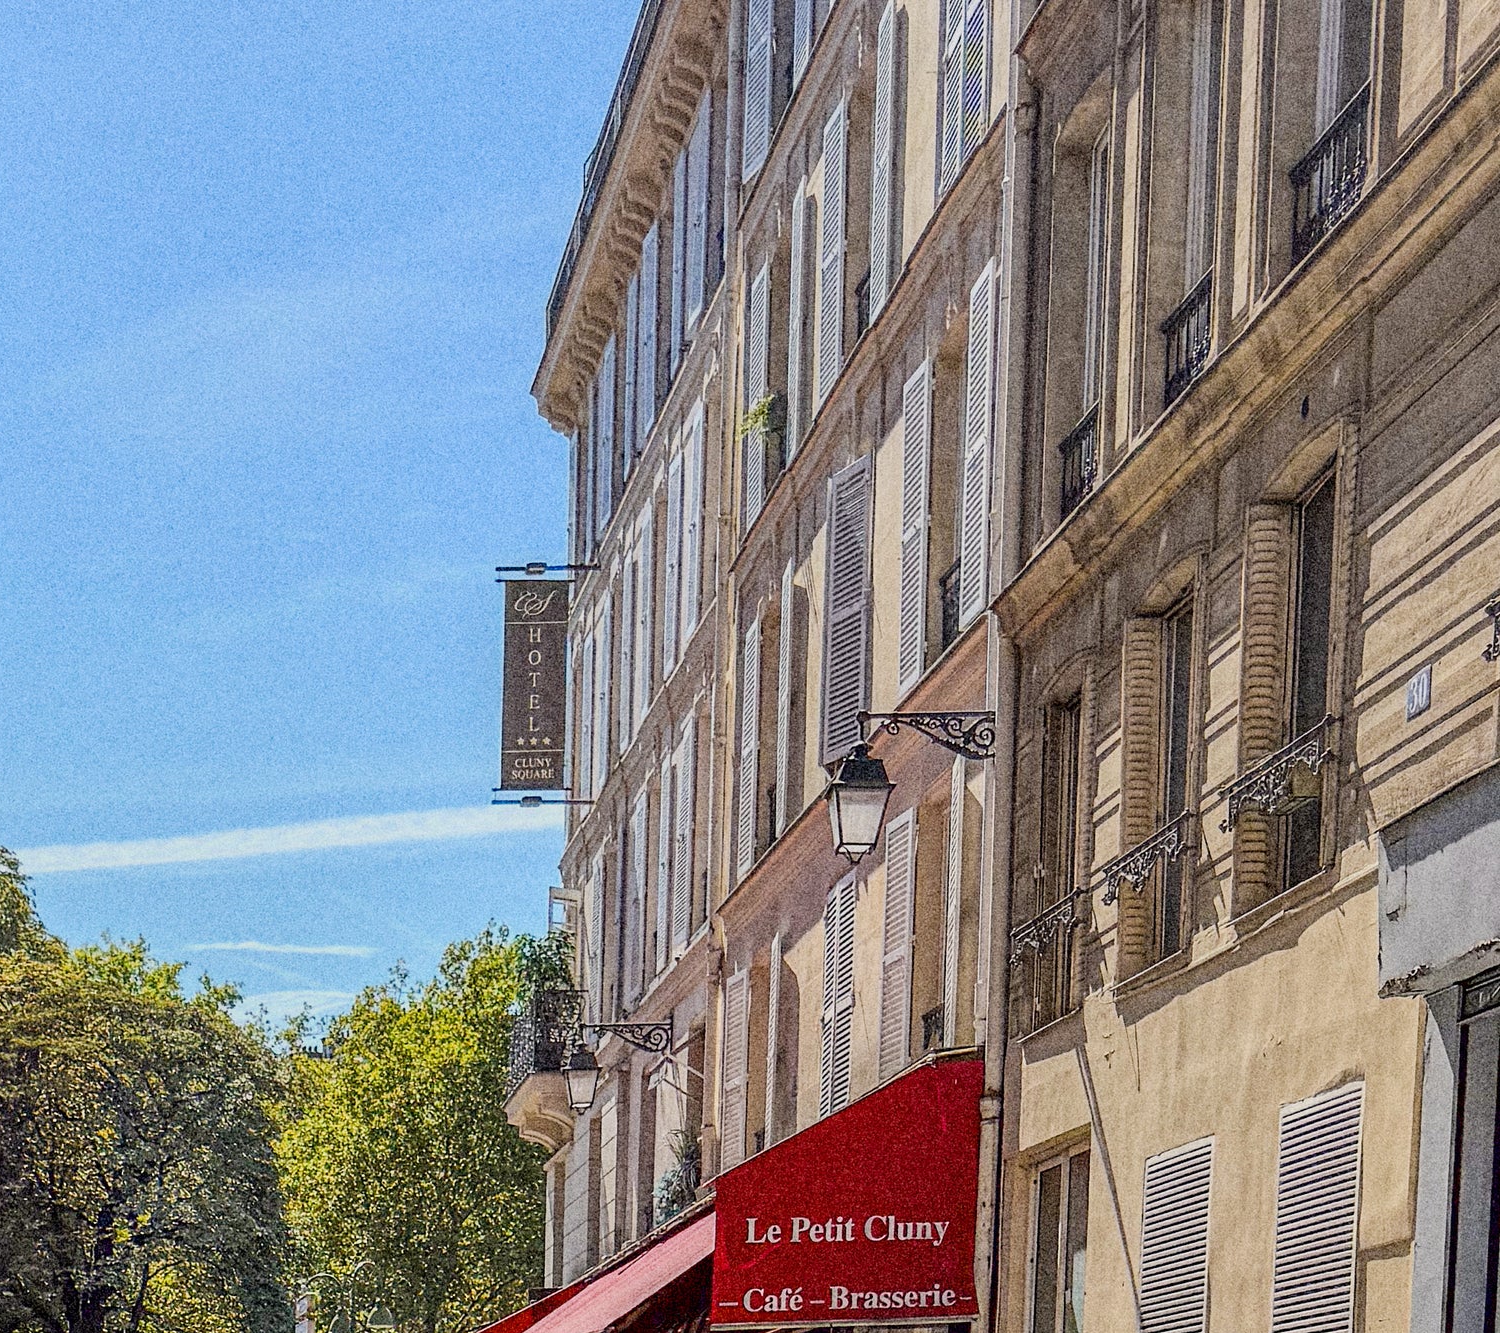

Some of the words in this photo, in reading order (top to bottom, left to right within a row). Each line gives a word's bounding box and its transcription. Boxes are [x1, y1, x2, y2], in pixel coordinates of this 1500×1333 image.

[528, 628, 542, 732] HOTEL
[1409, 673, 1427, 713] 30
[512, 768, 555, 780] SQUARE
[515, 758, 552, 769] CLUNY
[745, 1218, 781, 1245] Le
[790, 1216, 855, 1243] Petit
[864, 1215, 950, 1247] Cluny
[743, 1287, 803, 1313] Café
[829, 1284, 957, 1310] Brasserie
